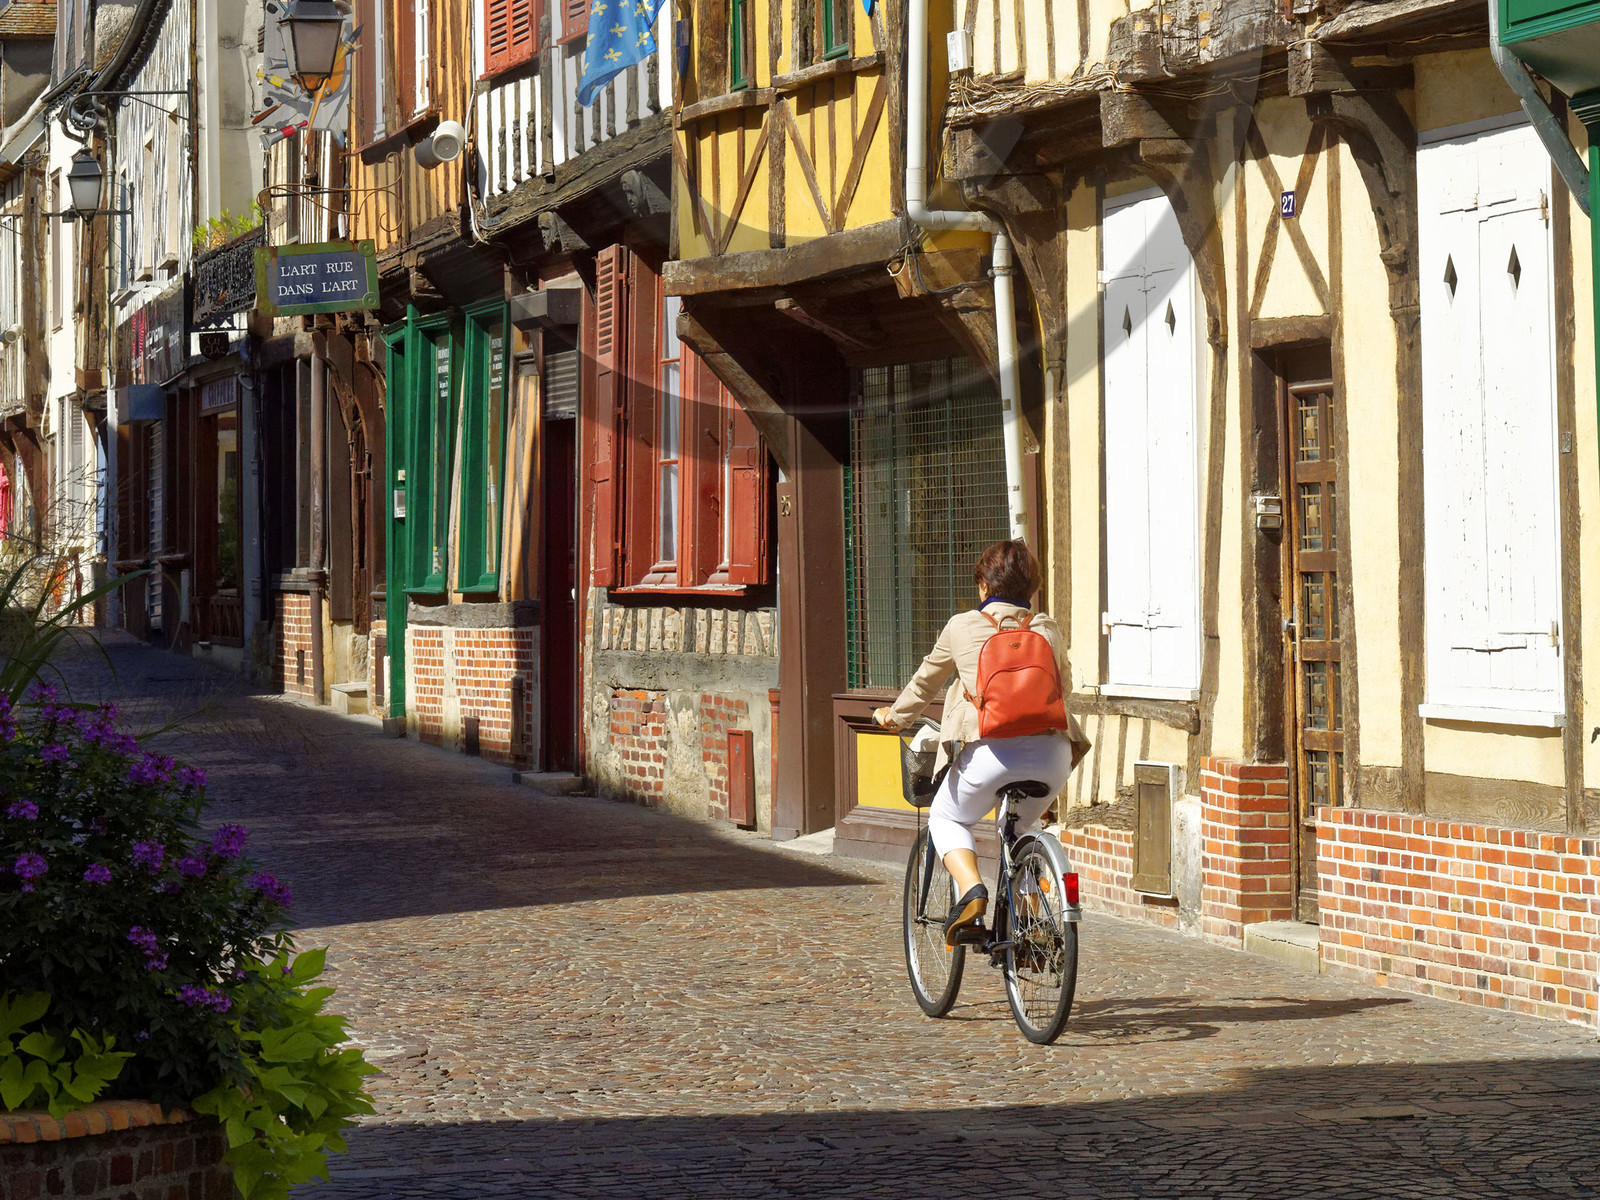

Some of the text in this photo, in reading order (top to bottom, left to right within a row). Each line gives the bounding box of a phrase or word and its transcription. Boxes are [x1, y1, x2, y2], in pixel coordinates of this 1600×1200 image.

[1282, 194, 1294, 213] 27
[280, 261, 353, 277] L'ART RUE
[278, 279, 359, 297] DANS L'ART
[780, 495, 791, 516] 25
